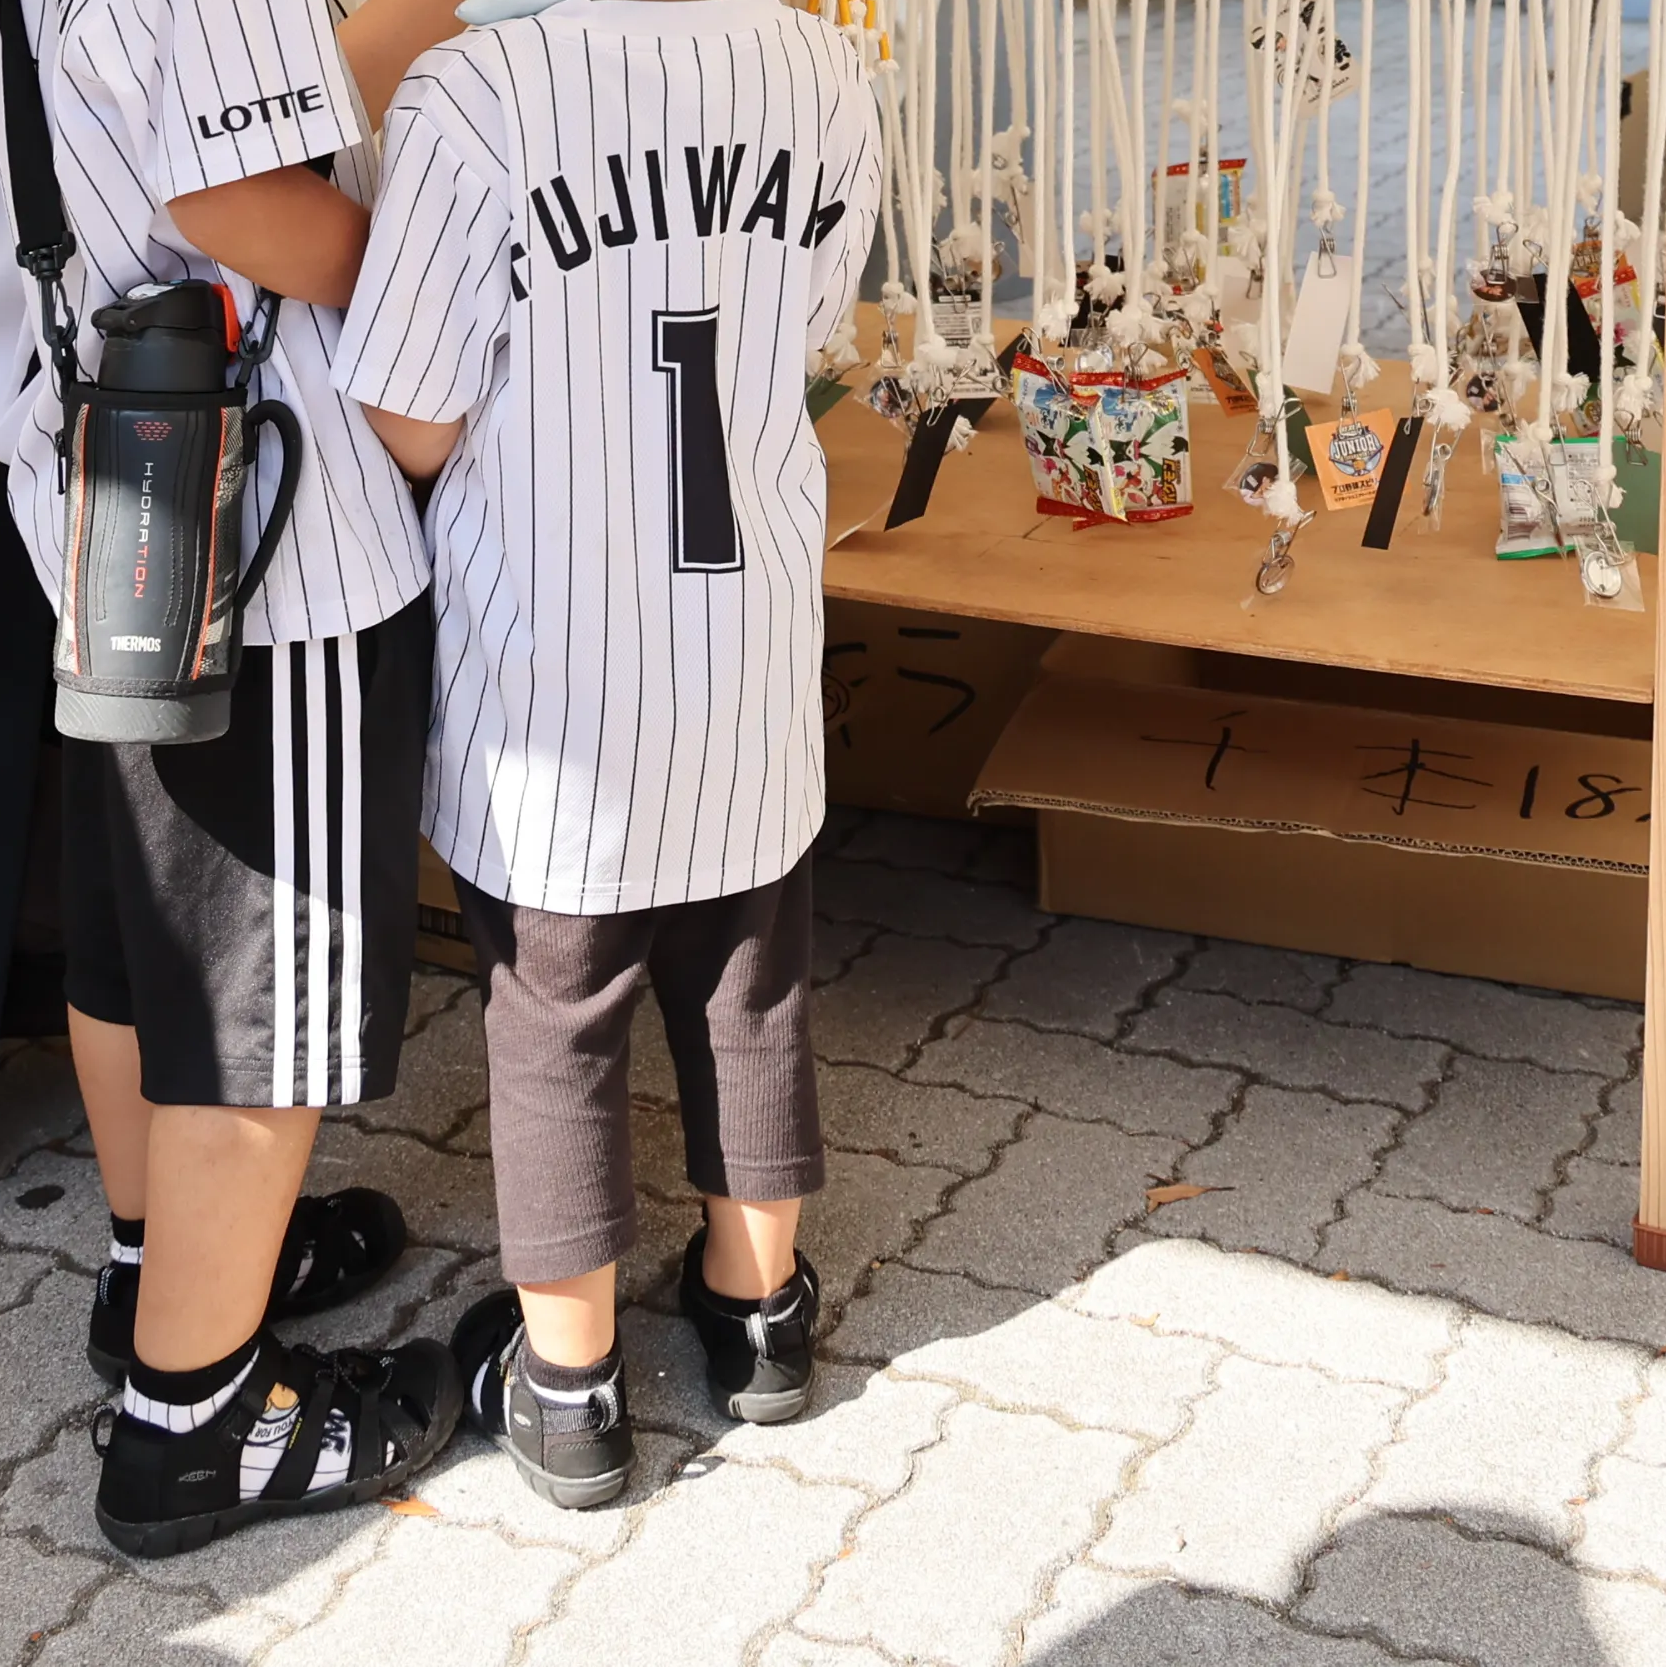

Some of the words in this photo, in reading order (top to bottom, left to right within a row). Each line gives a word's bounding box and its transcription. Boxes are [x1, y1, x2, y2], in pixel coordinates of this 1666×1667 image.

[197, 85, 324, 139] LOTTE
[652, 304, 746, 574] 1
[1334, 434, 1377, 459] JUNIOR
[1331, 478, 1380, 494] プロ野球スピリ
[134, 461, 154, 599] HYDRATION
[110, 635, 162, 653] THERMOS
[254, 1427, 273, 1439] FOR
[273, 1417, 294, 1436] YOU
[177, 1470, 217, 1483] KEEN
